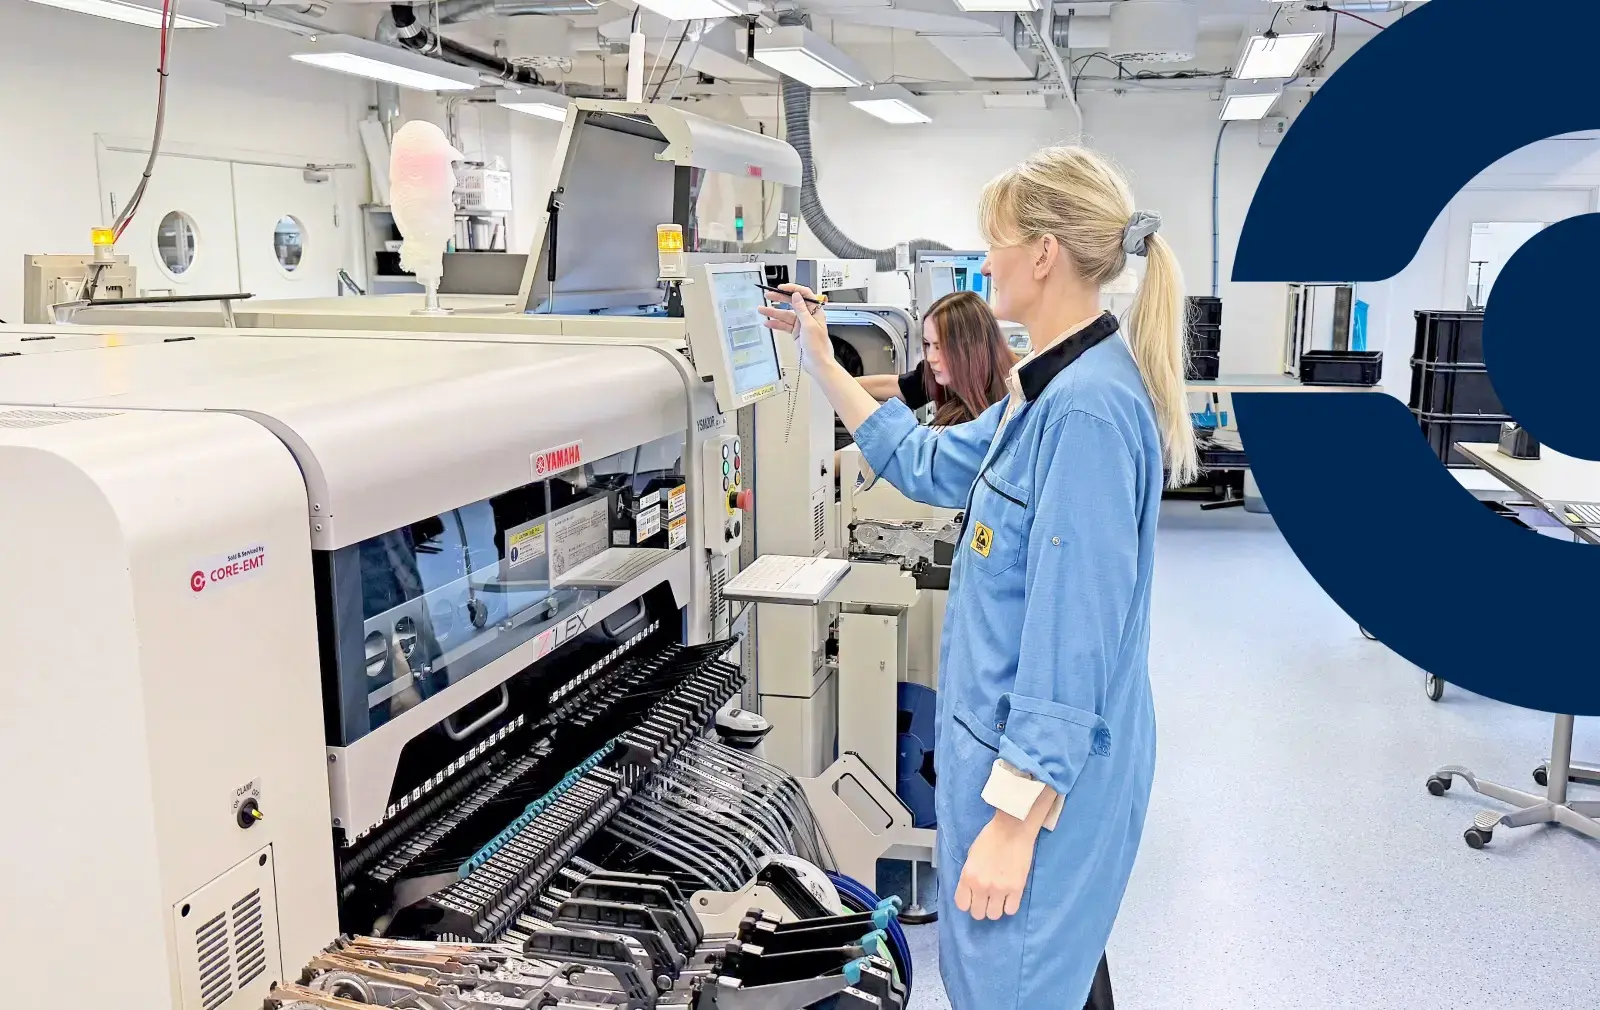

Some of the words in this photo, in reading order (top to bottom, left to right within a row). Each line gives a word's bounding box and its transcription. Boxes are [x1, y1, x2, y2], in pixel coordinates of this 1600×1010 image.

[545, 444, 580, 471] YAMAHA
[241, 547, 258, 557] Serviced
[210, 554, 264, 581] CORE-EMT
[236, 781, 253, 796] CLAMP
